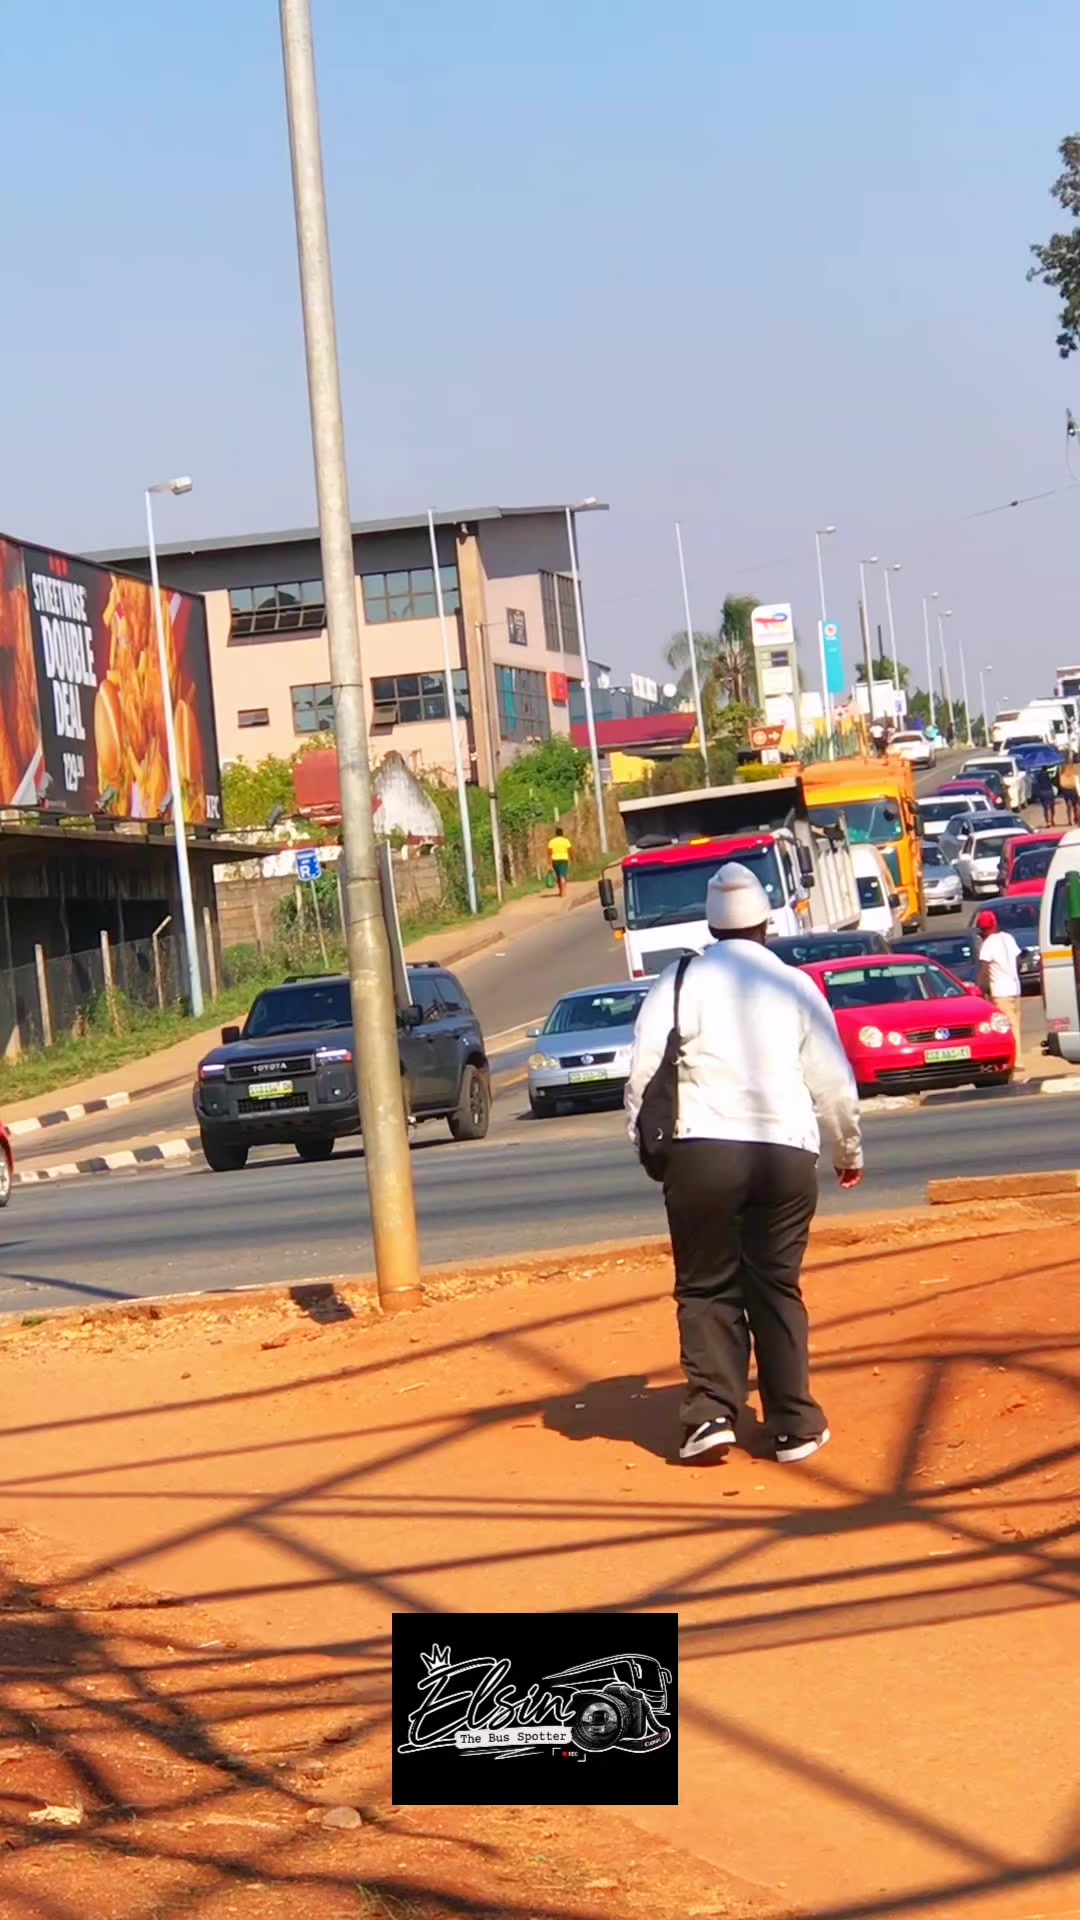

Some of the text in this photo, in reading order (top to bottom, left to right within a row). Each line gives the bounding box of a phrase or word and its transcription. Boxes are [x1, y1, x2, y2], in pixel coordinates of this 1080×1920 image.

[32, 572, 87, 622] STREETWISE
[40, 615, 97, 688] DOUBLE
[52, 679, 86, 741] DEAL
[252, 1062, 288, 1072] TOYOTA
